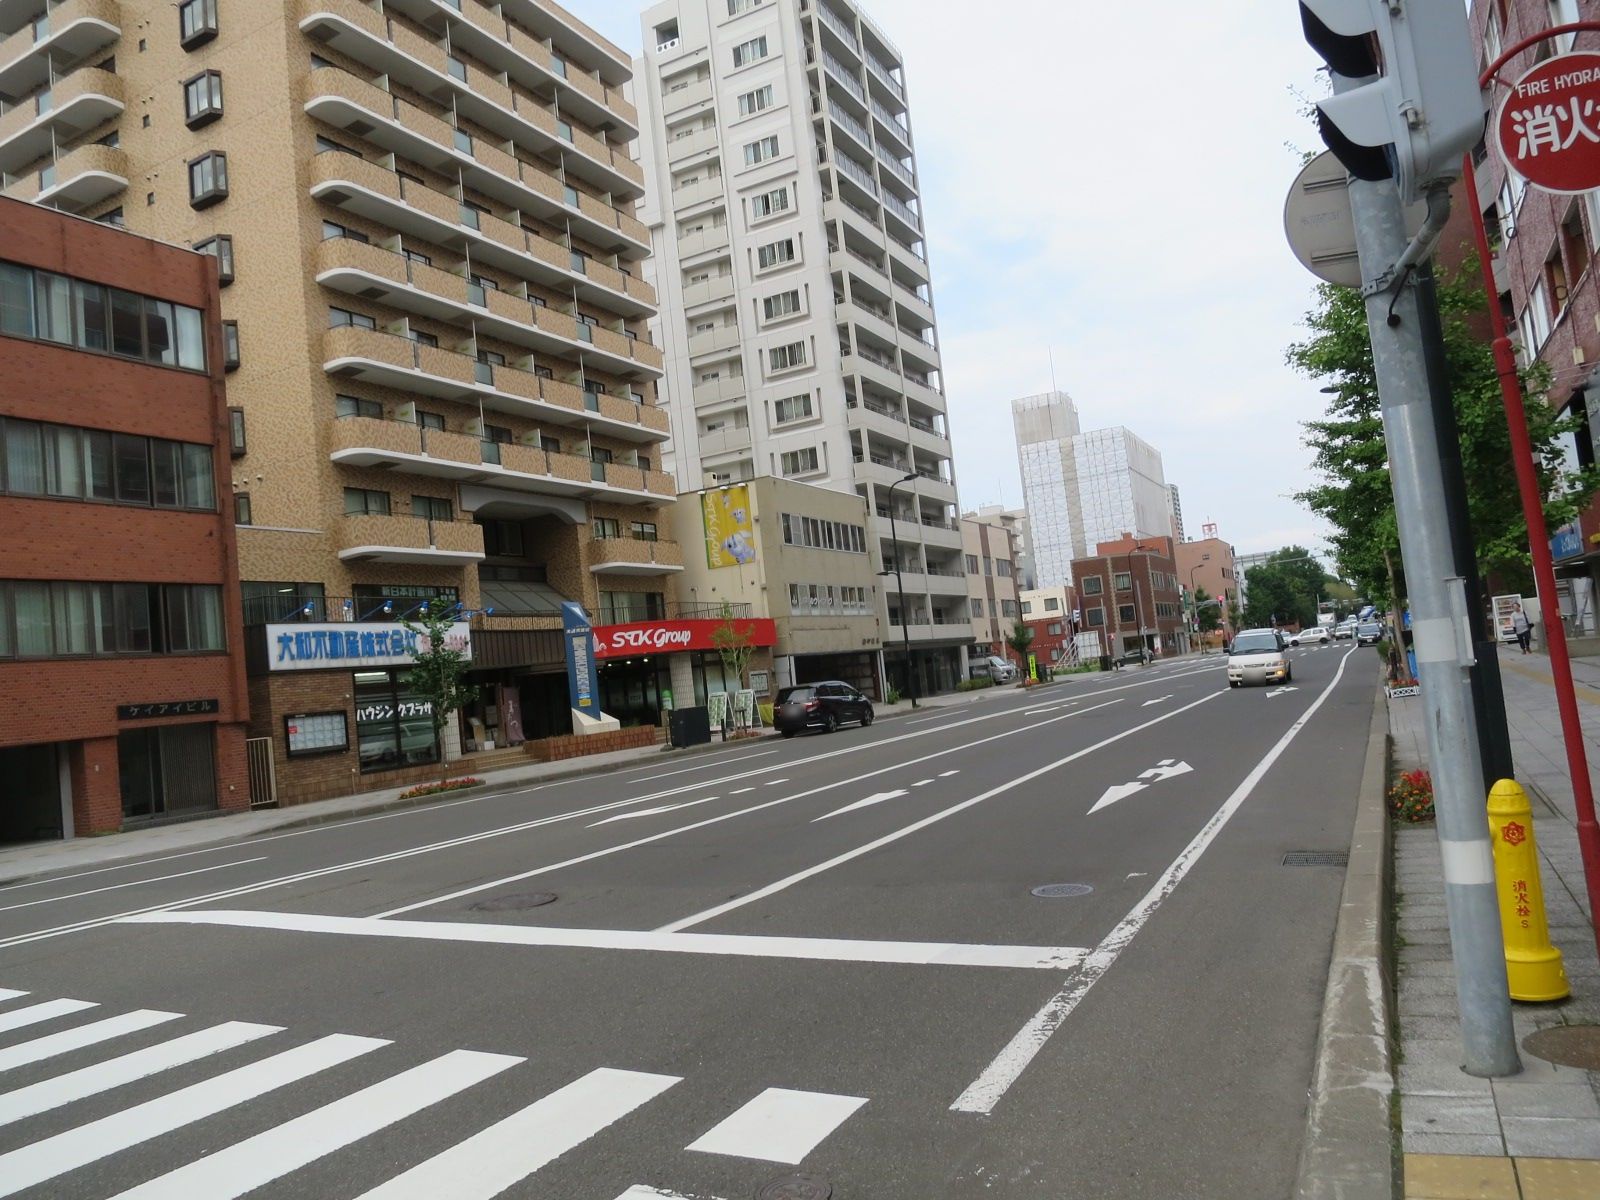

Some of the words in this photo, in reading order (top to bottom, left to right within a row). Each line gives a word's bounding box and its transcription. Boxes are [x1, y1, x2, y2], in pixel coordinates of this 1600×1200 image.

[1517, 79, 1550, 98] FIRE
[1510, 96, 1600, 160] 消火
[611, 629, 654, 648] STK
[653, 628, 691, 648] Group
[129, 701, 212, 716] ケイアイビル
[1512, 880, 1531, 917] 消火栓
